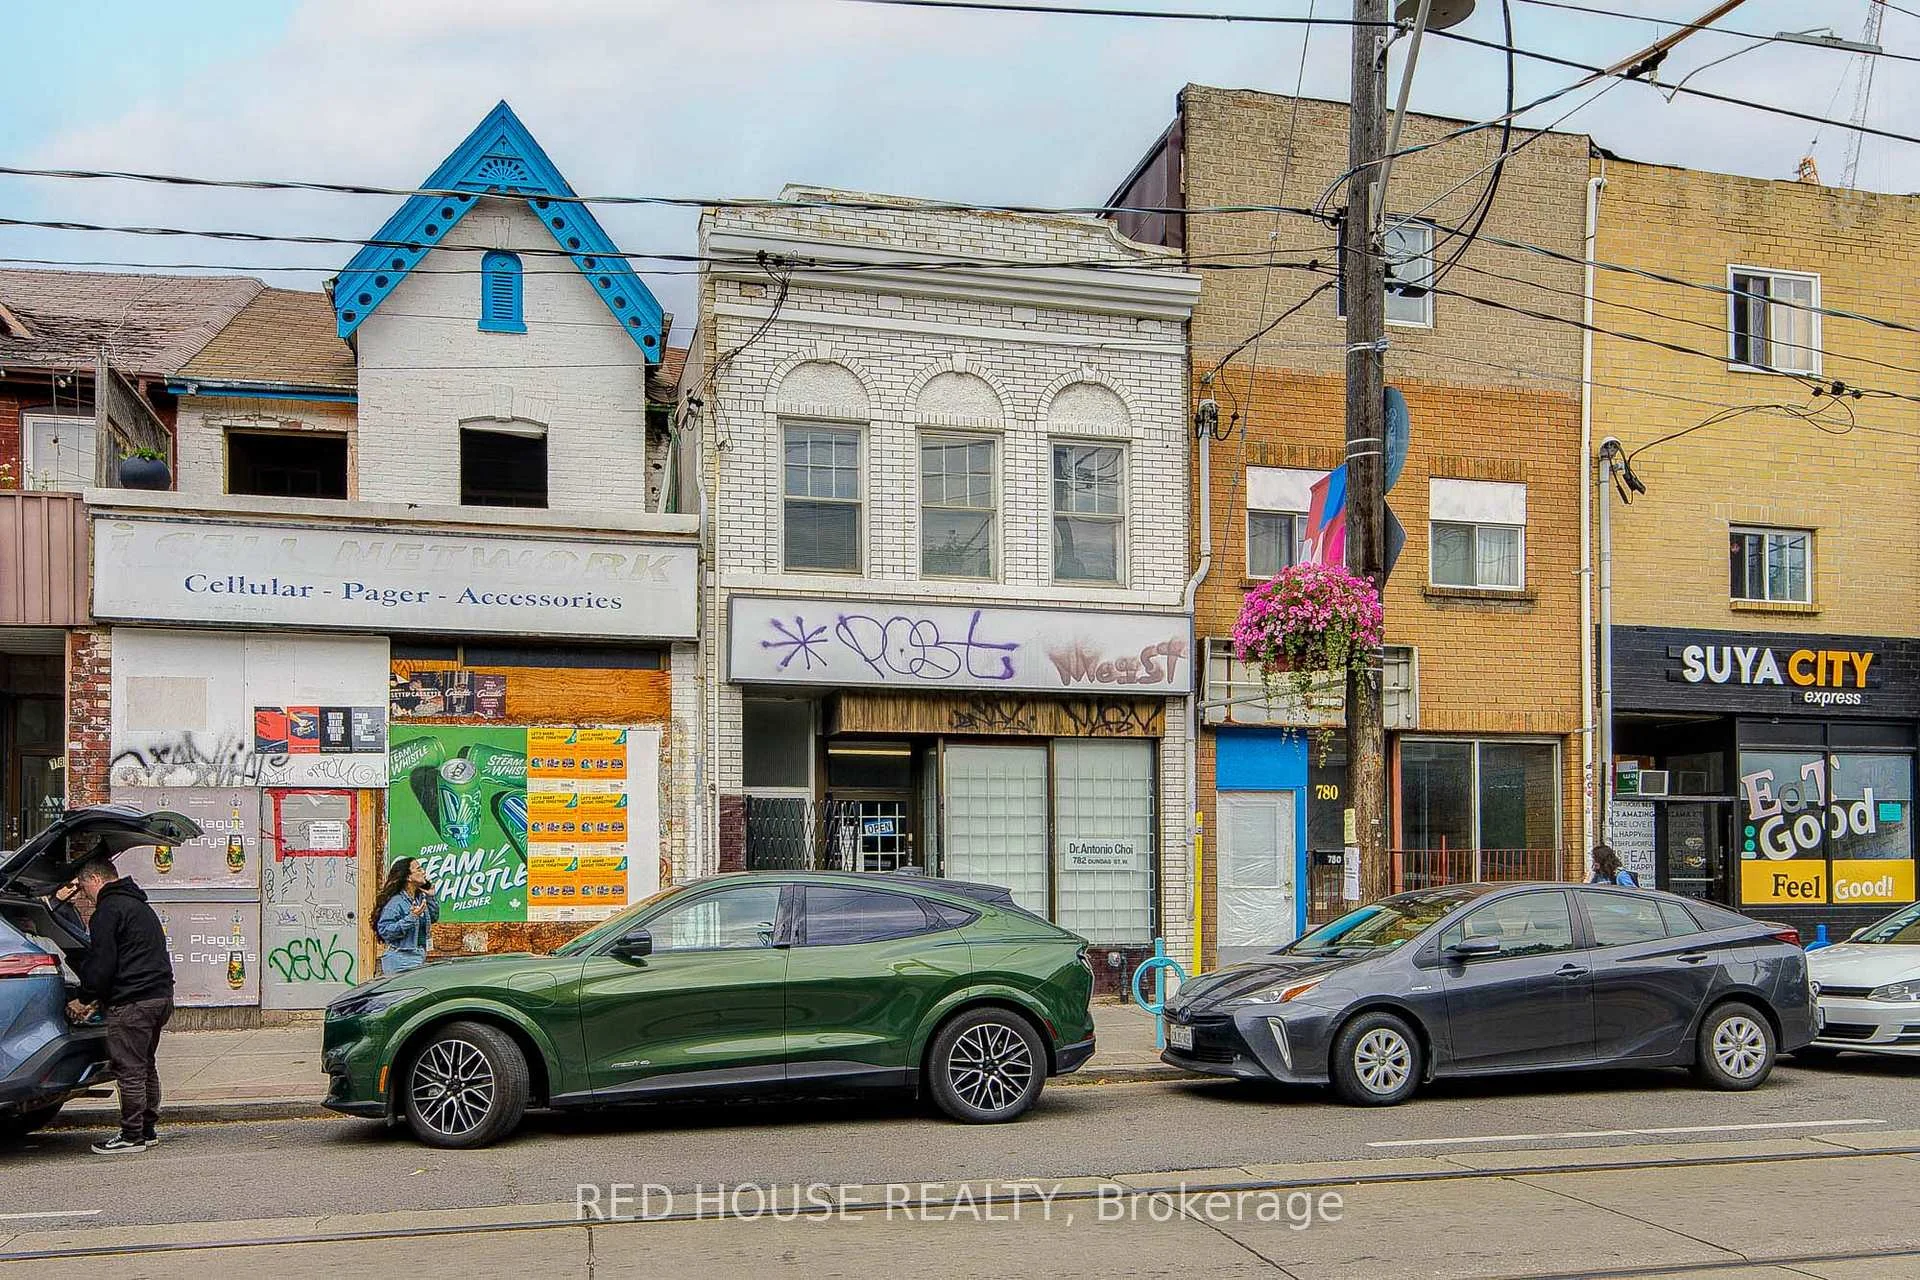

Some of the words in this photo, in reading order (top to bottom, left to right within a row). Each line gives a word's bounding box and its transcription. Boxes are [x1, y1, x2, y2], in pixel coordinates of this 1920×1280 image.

[184, 574, 313, 598] Cellular
[342, 582, 431, 607] Pager
[456, 587, 623, 610] Accessories
[1682, 645, 1784, 685] SUYA
[1788, 649, 1874, 688] CITY
[1804, 691, 1862, 707] express
[390, 746, 412, 764] TEAM
[487, 754, 525, 767] STEAM
[1315, 785, 1339, 800] 780
[867, 821, 892, 834] OPEN
[1759, 787, 1877, 861] Good
[420, 843, 449, 855] DRINK
[1080, 843, 1113, 855] Antonio
[1114, 843, 1134, 855] Choi
[1072, 856, 1087, 865] 782
[1327, 855, 1342, 865] 780
[1630, 850, 1655, 863] EAT
[1630, 863, 1654, 871] HAPPY
[1772, 873, 1821, 898] Feel
[1834, 876, 1895, 900] Good!
[452, 895, 492, 912] PILSNER
[190, 934, 245, 948] Plague
